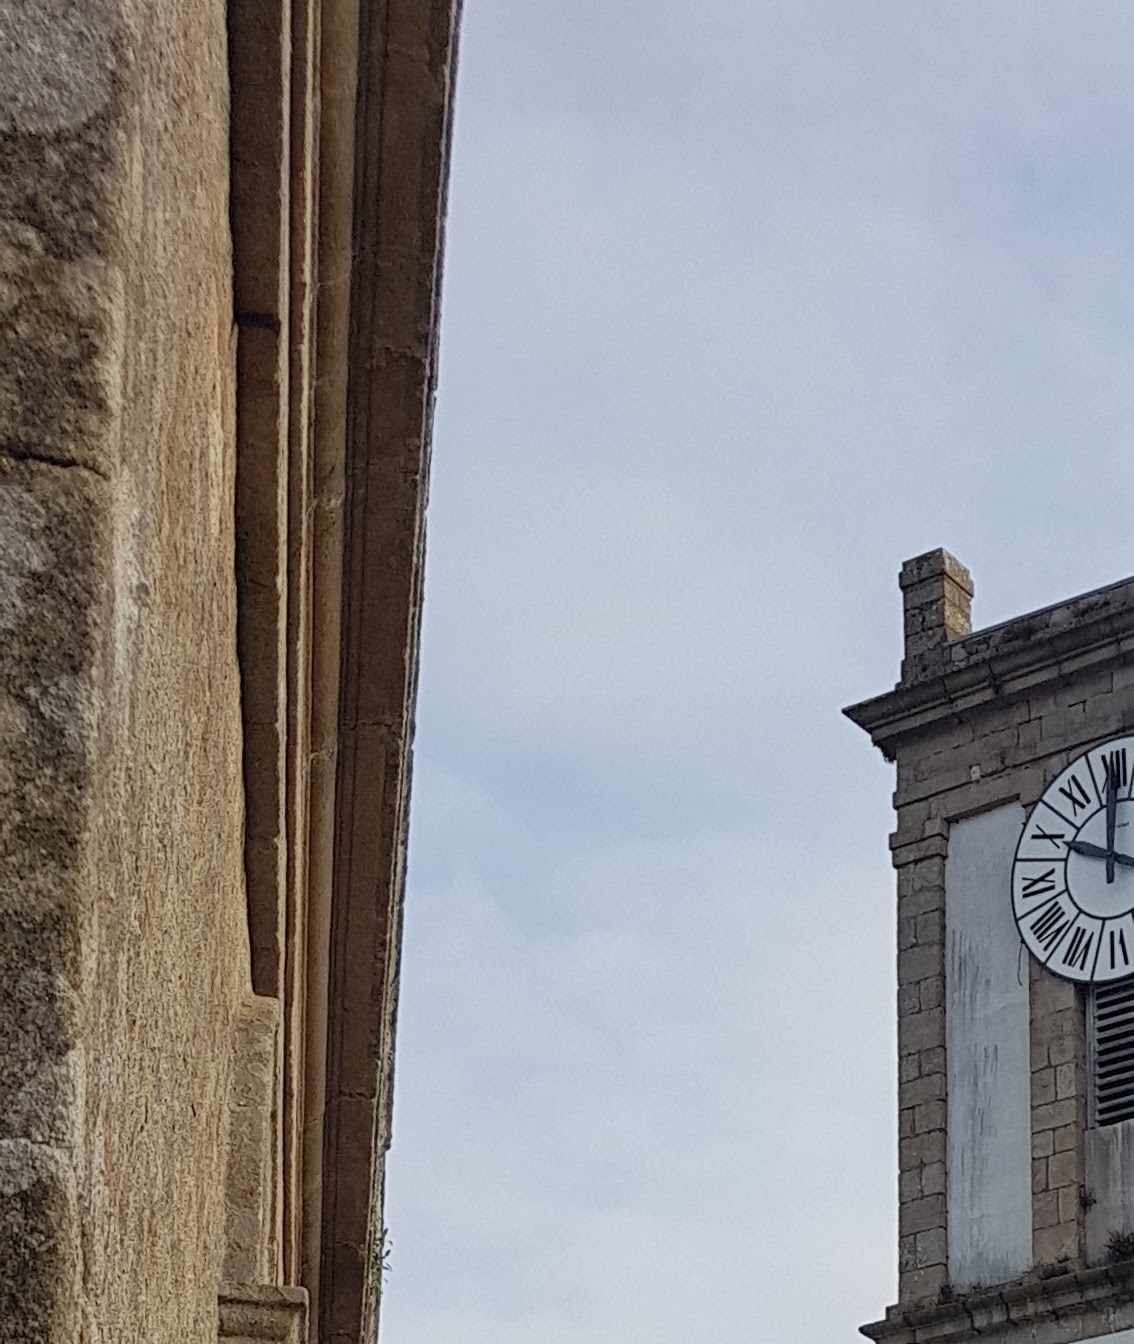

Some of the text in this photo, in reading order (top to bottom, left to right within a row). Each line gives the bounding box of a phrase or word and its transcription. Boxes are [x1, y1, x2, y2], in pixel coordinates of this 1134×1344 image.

[1059, 775, 1091, 817] XI
[1031, 824, 1066, 849] X
[1022, 868, 1055, 898] IX
[1030, 901, 1070, 951] VIII
[1062, 926, 1094, 971] VII
[1110, 928, 1129, 969] VI
